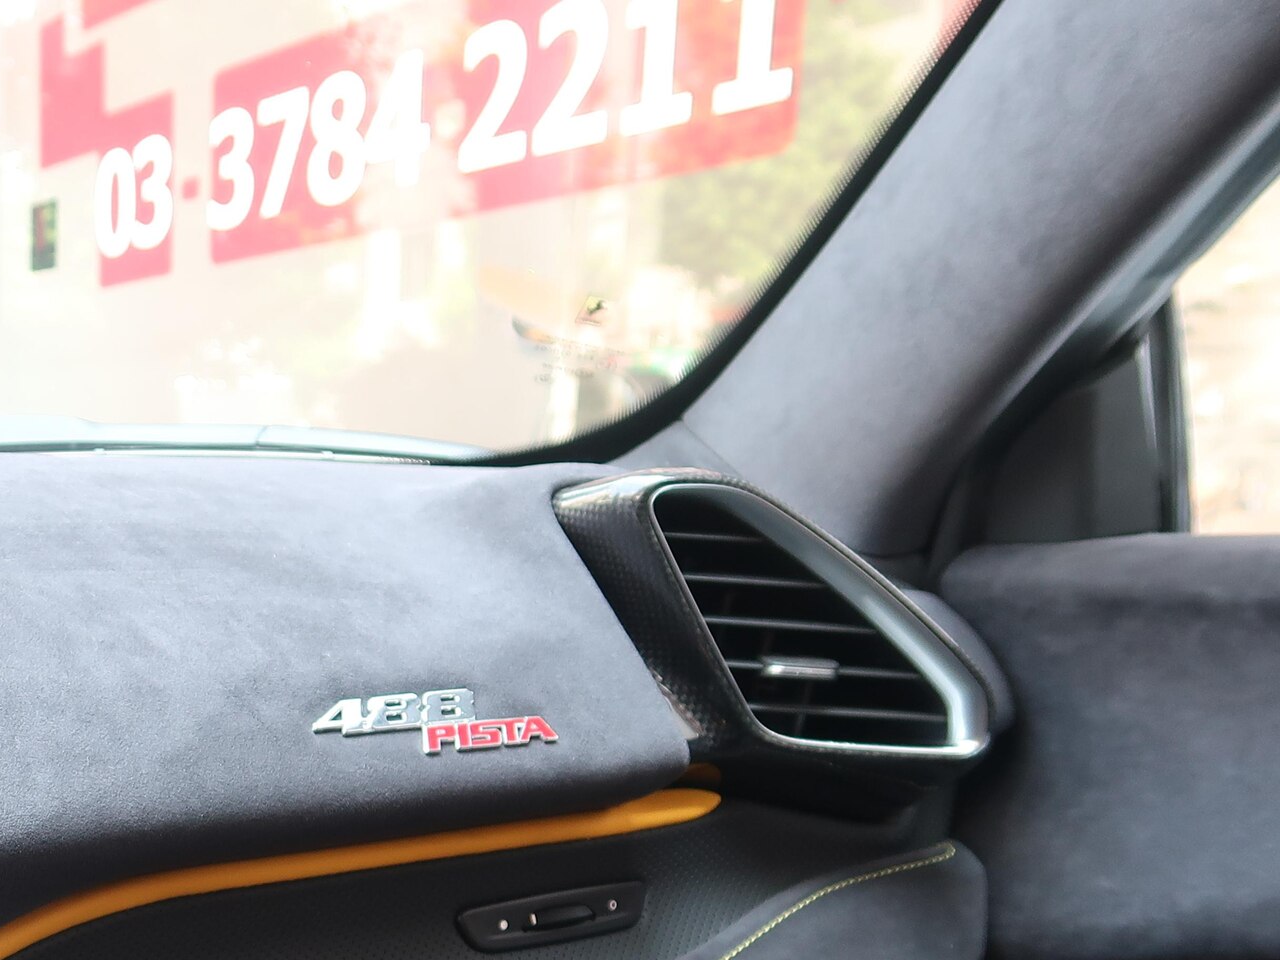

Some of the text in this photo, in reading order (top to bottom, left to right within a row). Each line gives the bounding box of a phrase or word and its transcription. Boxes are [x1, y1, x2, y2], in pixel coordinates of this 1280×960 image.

[94, 0, 793, 258] 03 3784 2211
[312, 688, 475, 737] 488
[422, 715, 559, 754] PISTA
